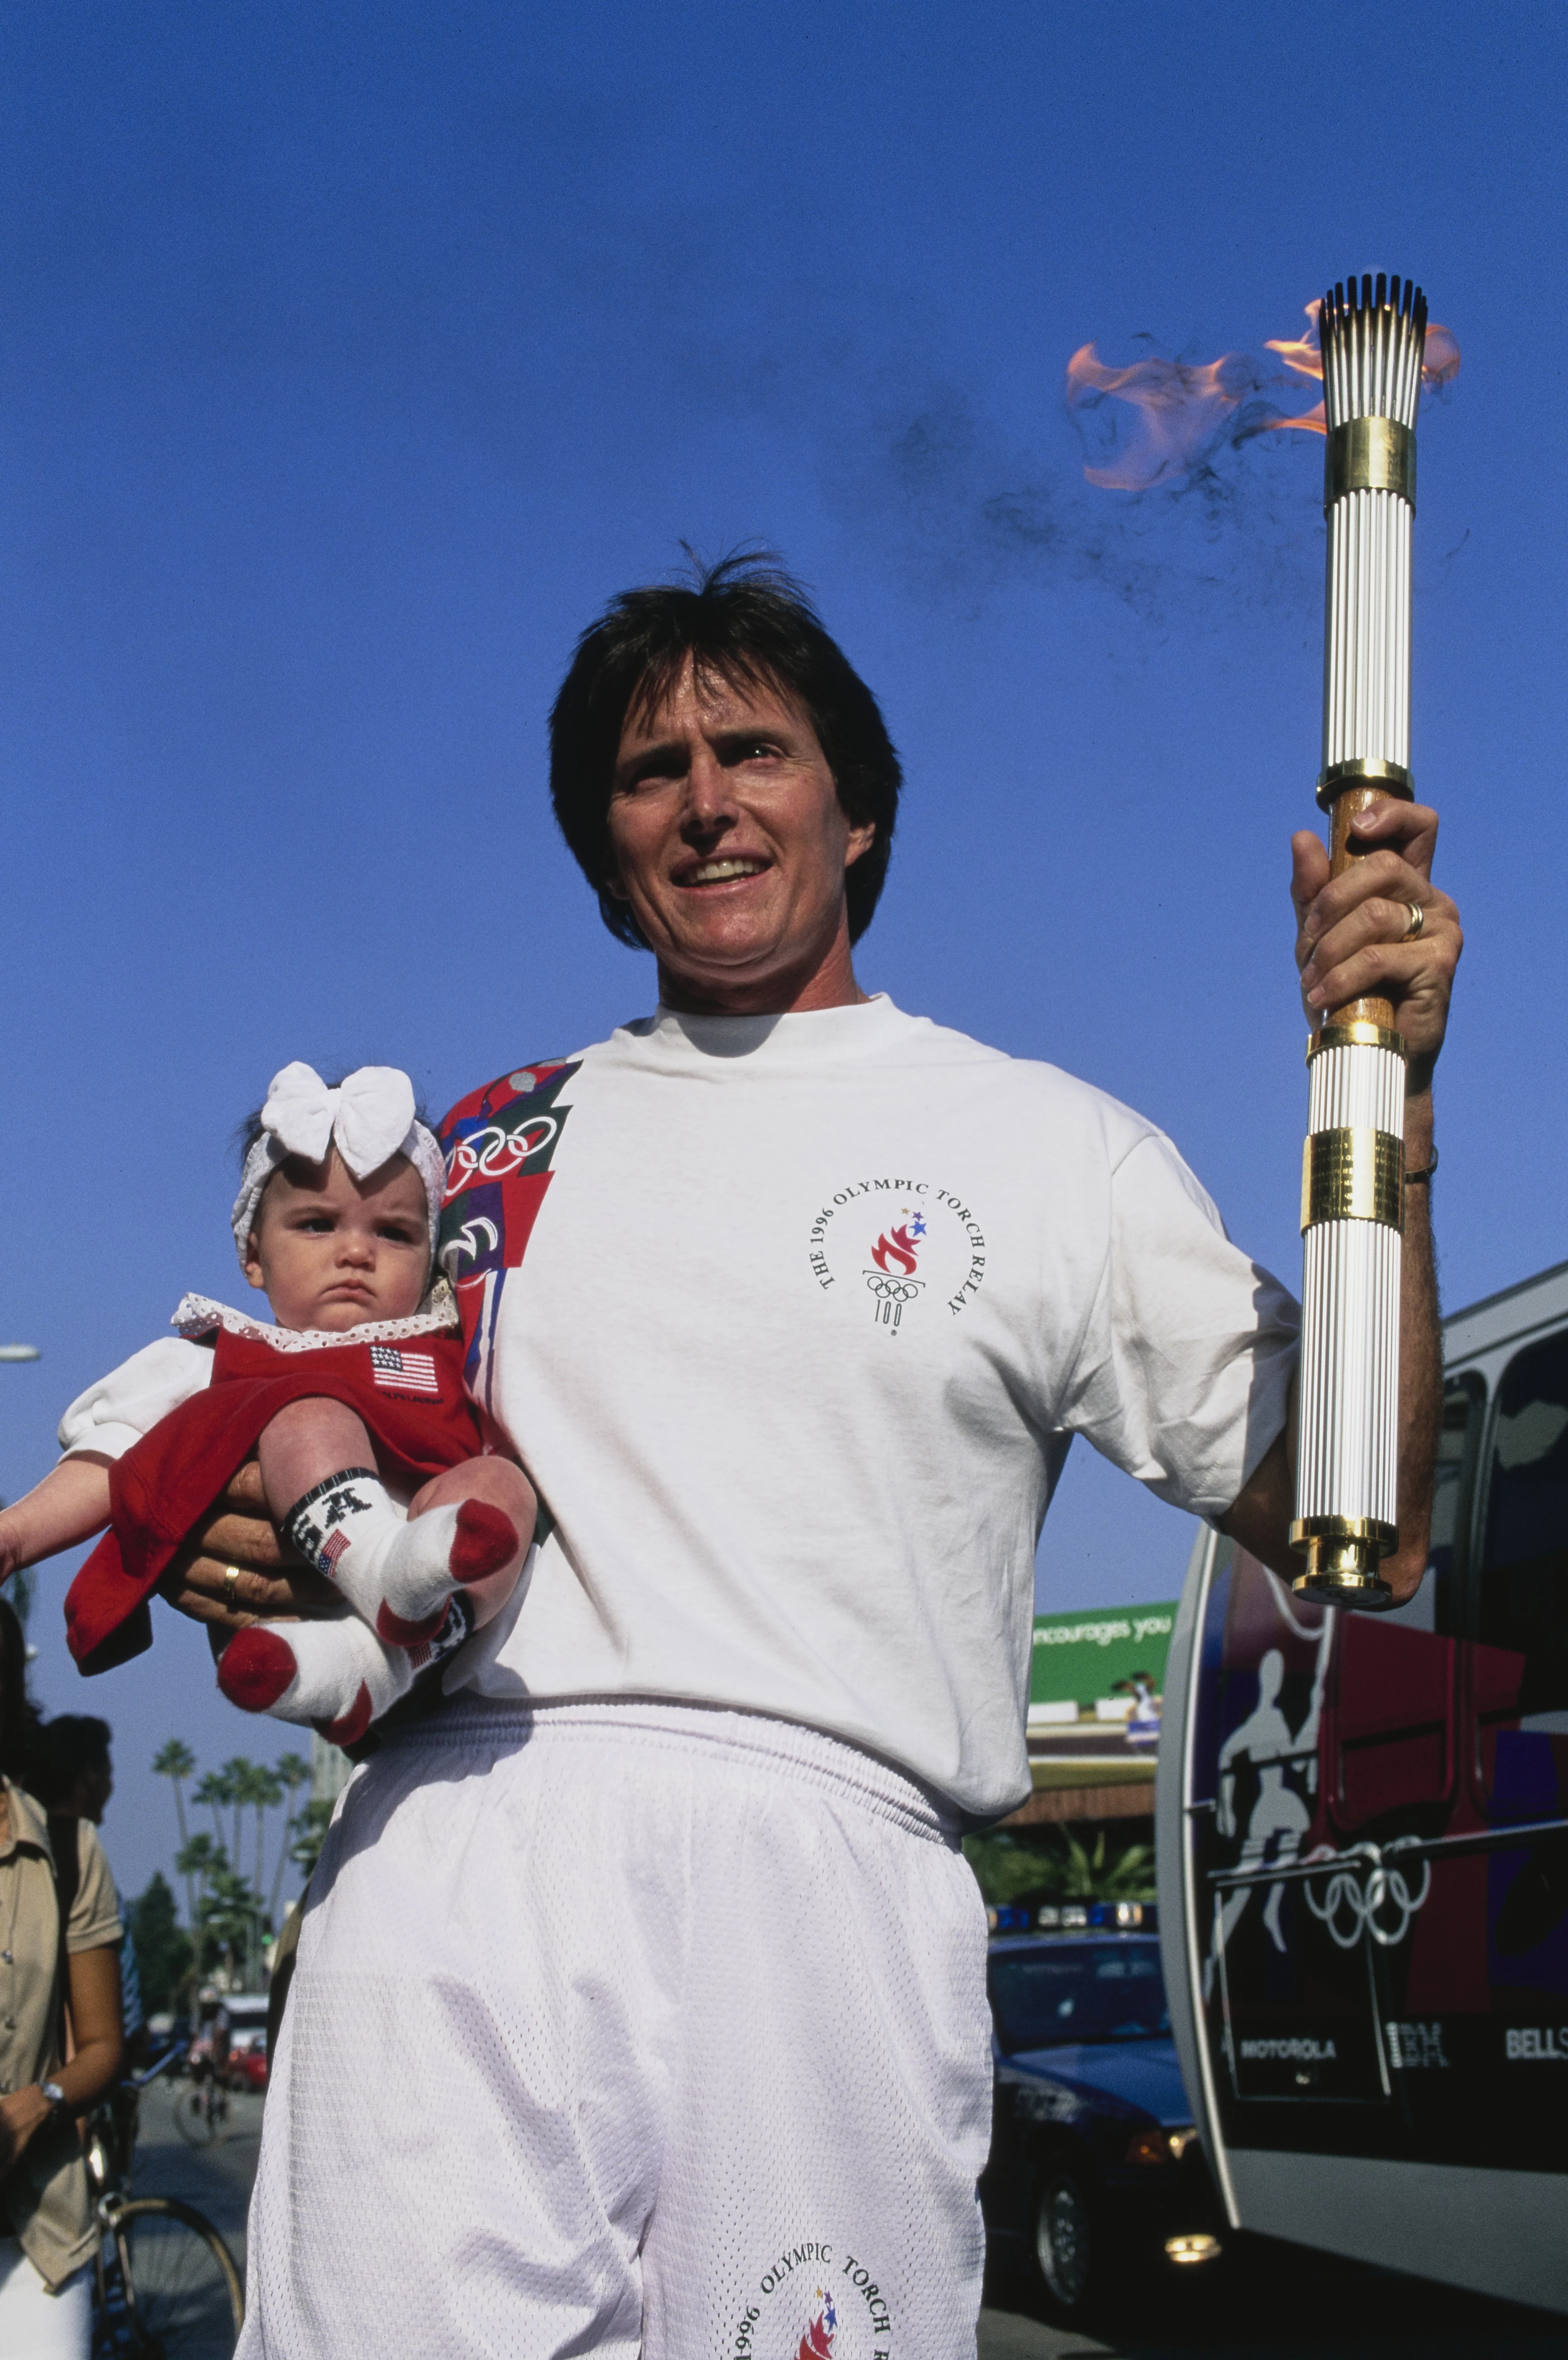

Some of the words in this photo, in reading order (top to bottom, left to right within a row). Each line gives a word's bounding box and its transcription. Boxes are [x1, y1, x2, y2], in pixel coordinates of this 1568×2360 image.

[833, 1179, 929, 1205] OLYMPIC
[810, 1207, 834, 1244] 1996
[936, 1190, 985, 1248] TORCH
[809, 1251, 835, 1290] THE
[947, 1254, 985, 1315] RELAY
[1133, 1616, 1171, 1643] you
[1241, 2038, 1336, 2060] MOTOROLA
[761, 2243, 832, 2294] OLYMPIC
[842, 2256, 891, 2333] TORCH
